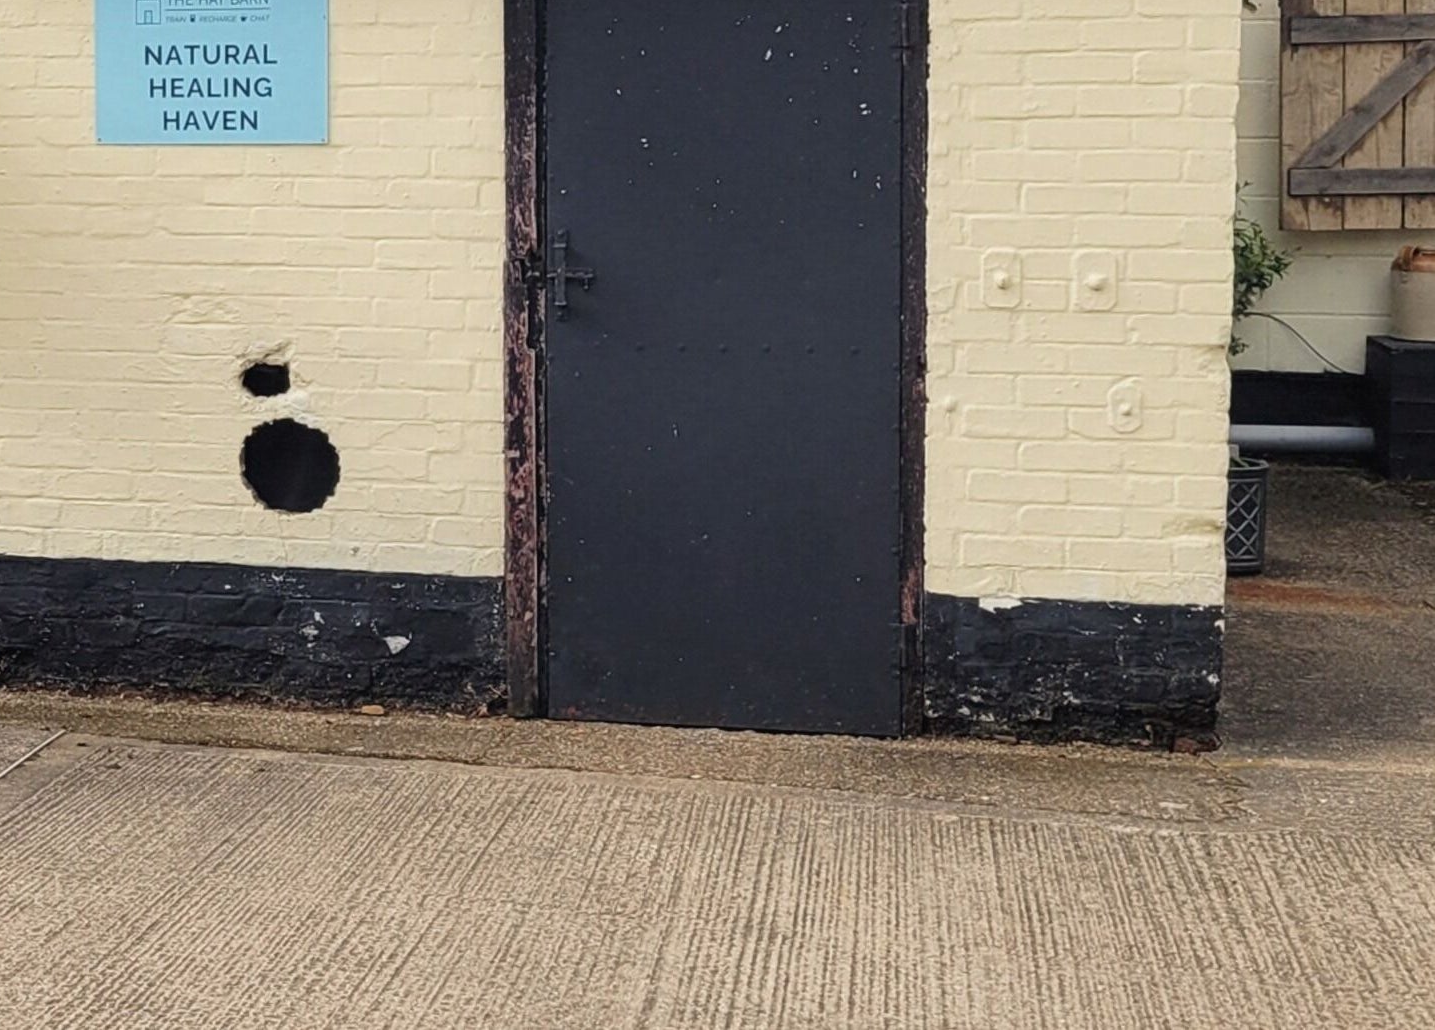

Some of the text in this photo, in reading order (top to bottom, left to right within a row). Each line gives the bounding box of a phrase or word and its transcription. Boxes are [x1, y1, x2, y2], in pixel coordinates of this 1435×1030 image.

[144, 44, 278, 65] NATURAL
[149, 77, 273, 98] HEALING
[163, 110, 259, 131] HAVEN
